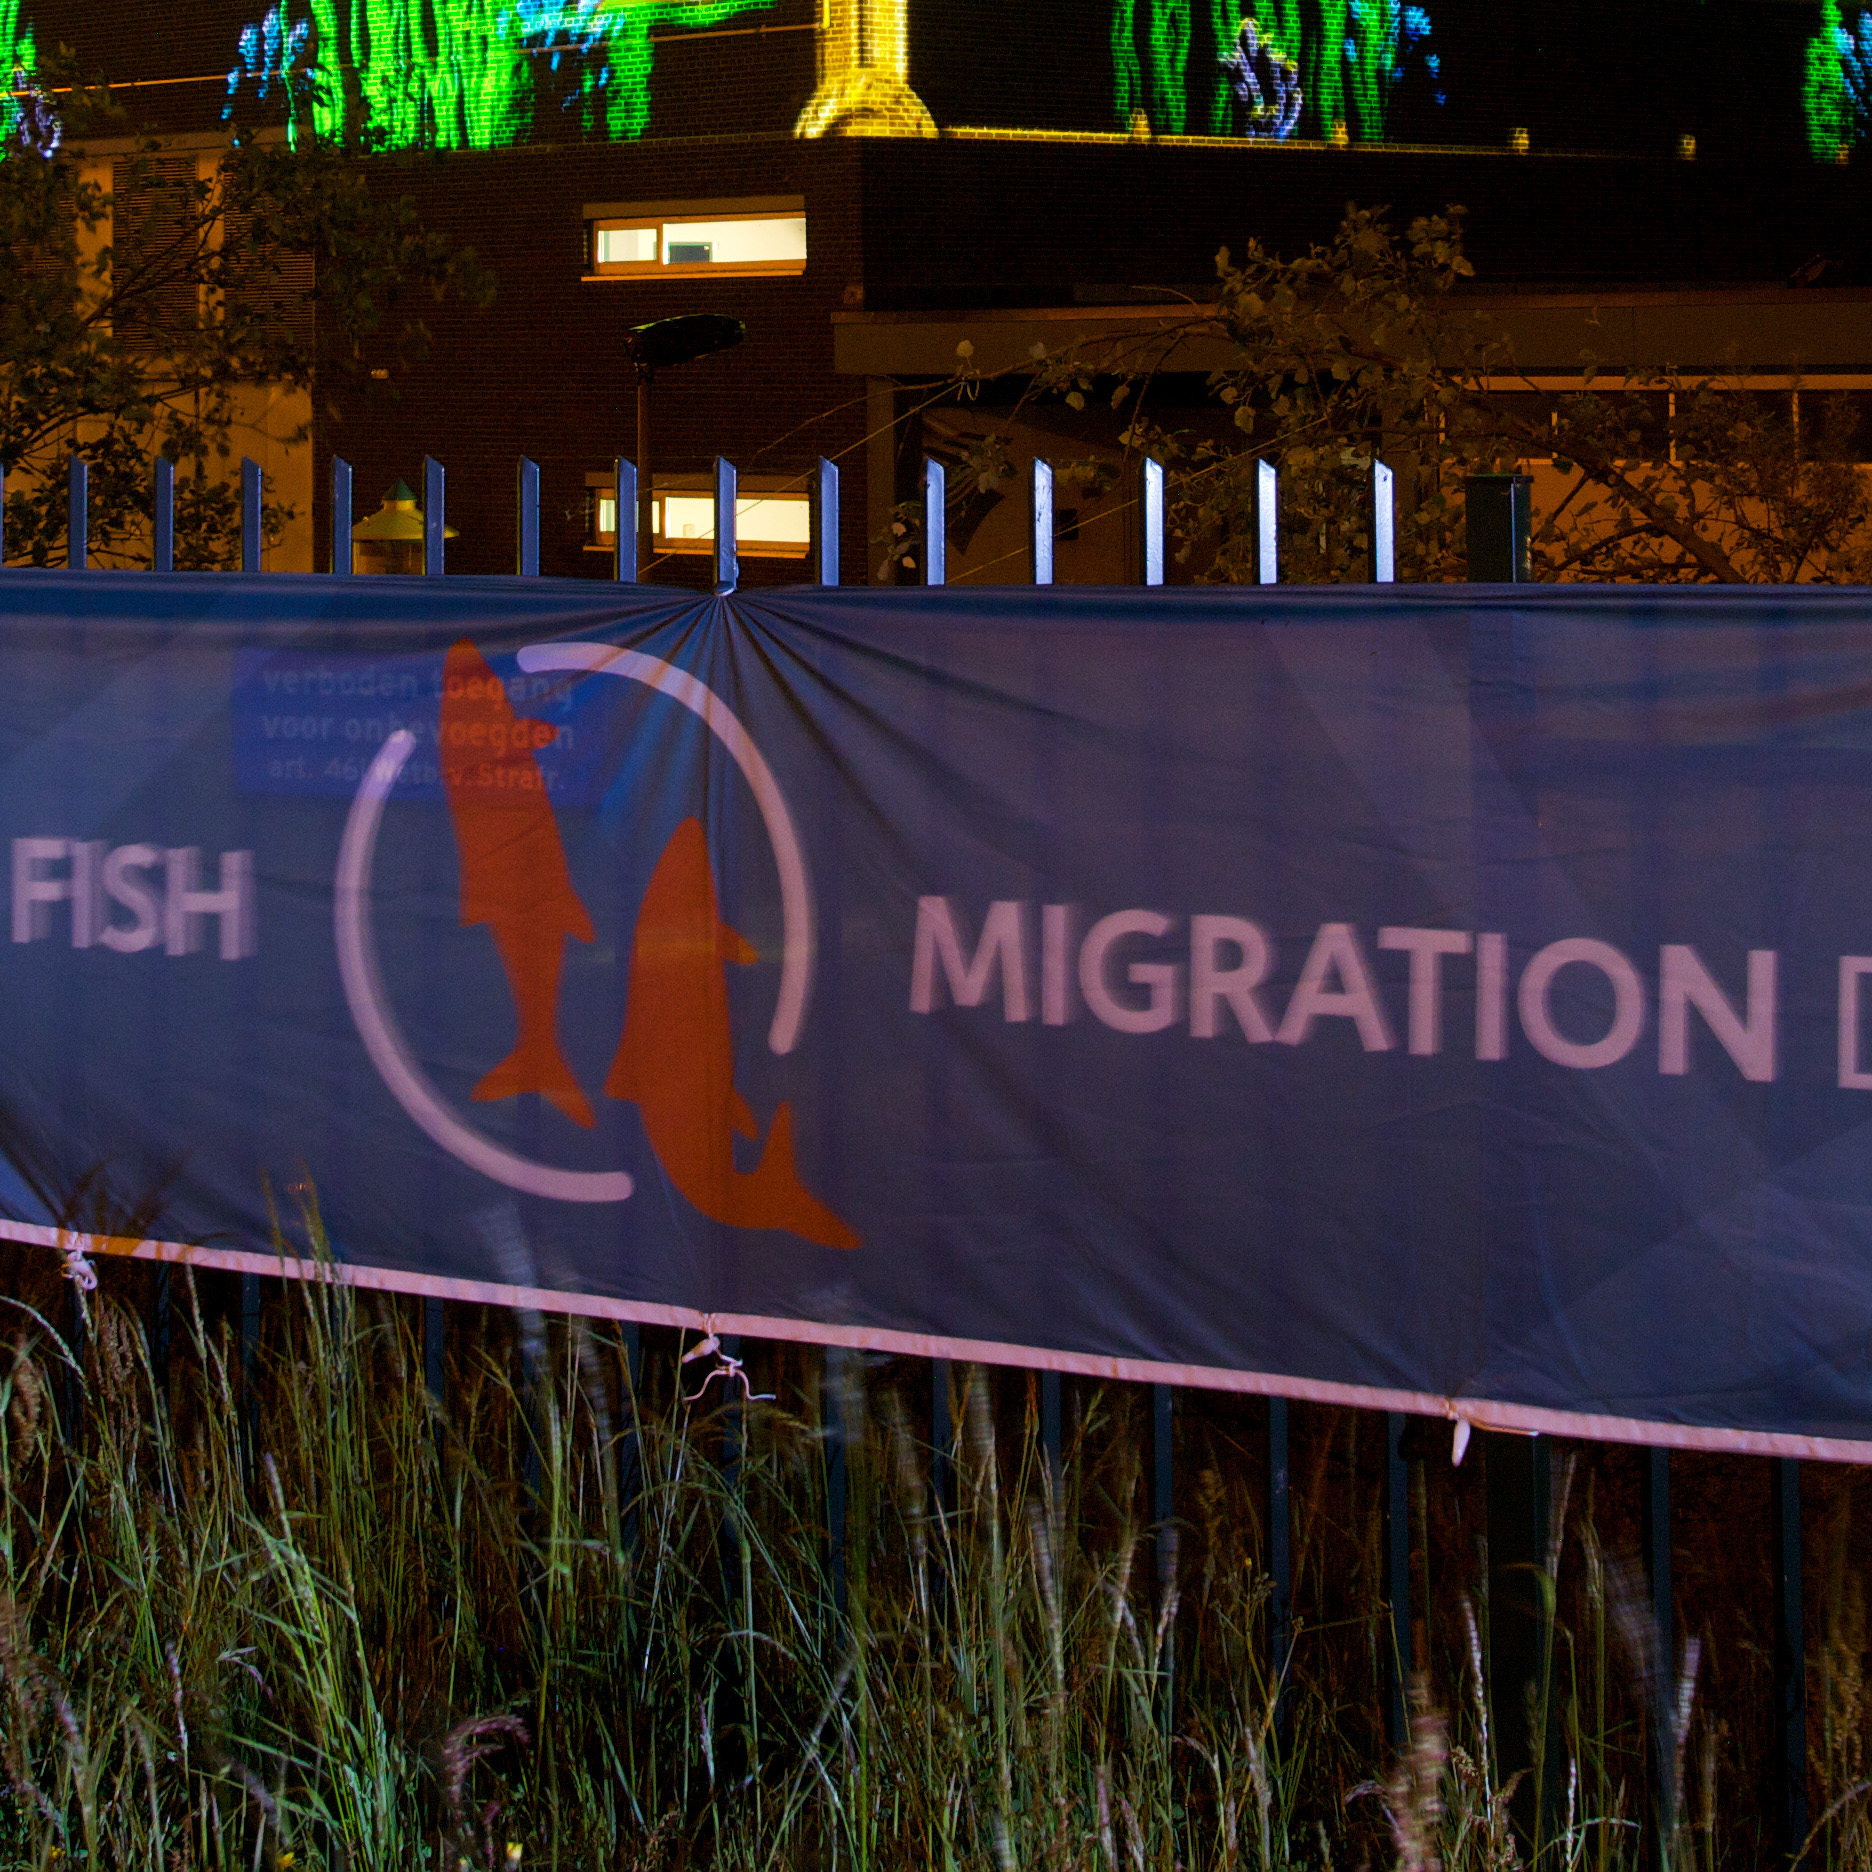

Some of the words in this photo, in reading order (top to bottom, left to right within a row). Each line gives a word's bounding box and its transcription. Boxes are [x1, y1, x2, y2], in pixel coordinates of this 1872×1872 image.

[261, 666, 419, 699] verboden
[432, 671, 575, 713] toegang
[261, 713, 334, 741] voor
[11, 837, 258, 961] FISH
[909, 895, 1778, 1083] MIGRATION
